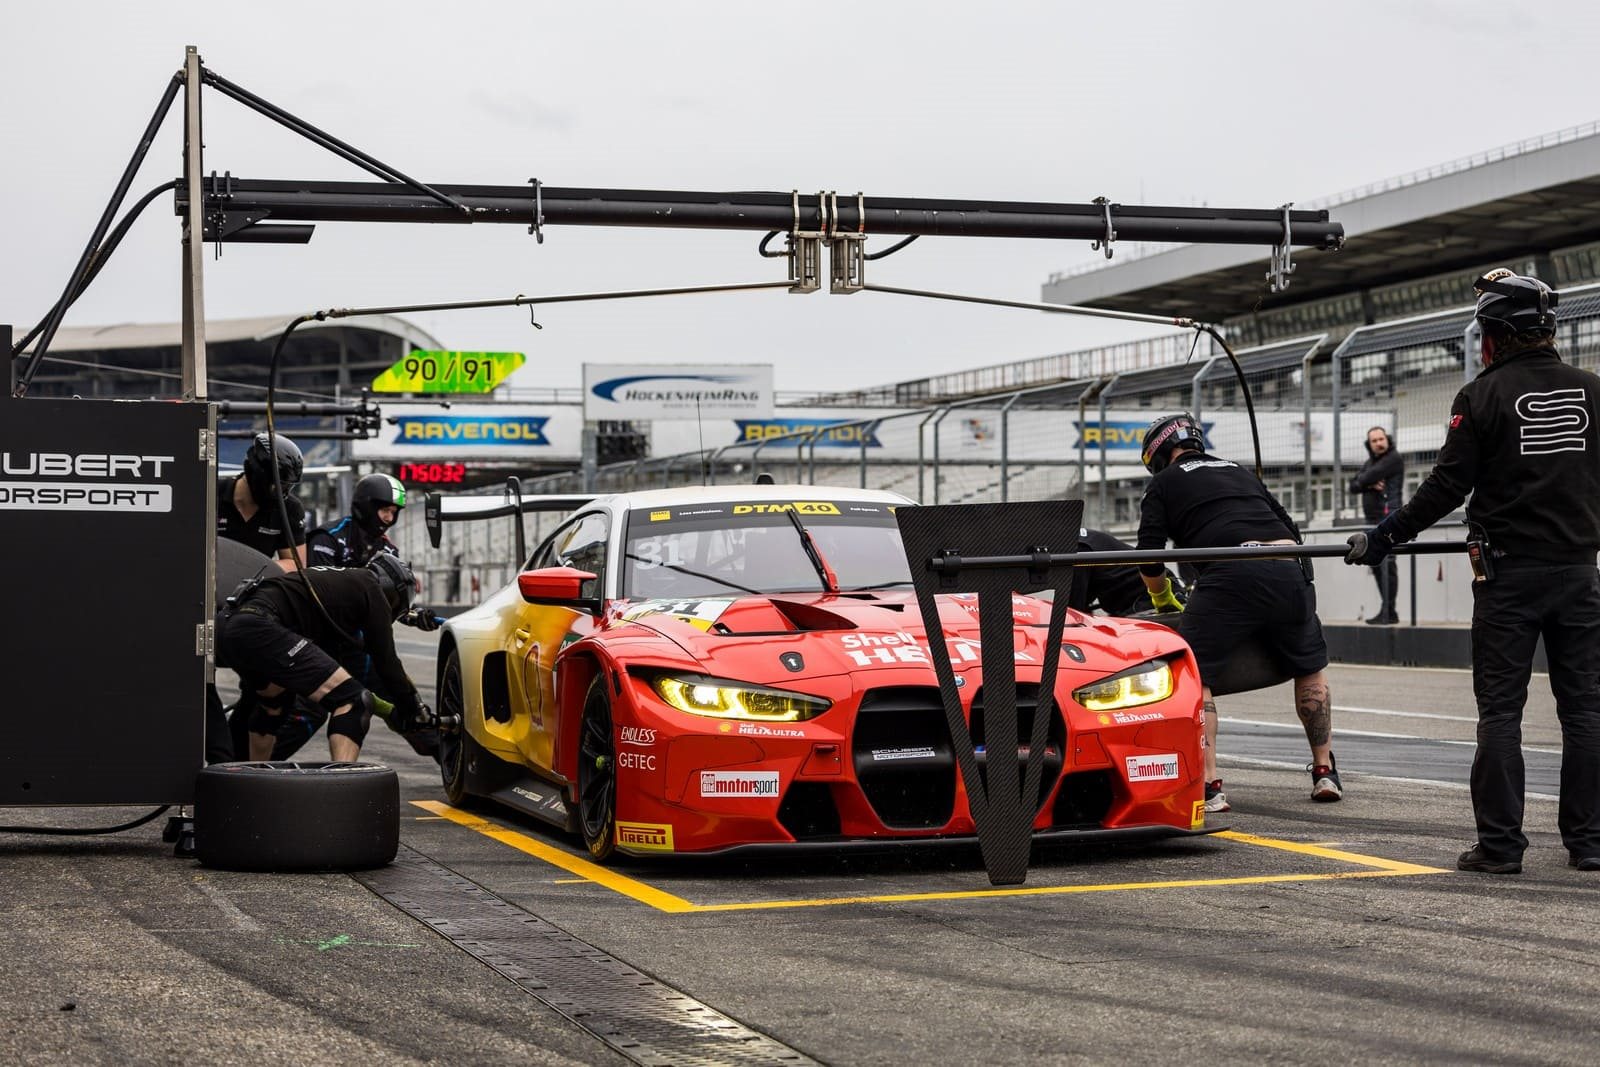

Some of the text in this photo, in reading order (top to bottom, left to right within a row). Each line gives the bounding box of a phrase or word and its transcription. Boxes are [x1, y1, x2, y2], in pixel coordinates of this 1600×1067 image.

[405, 359, 436, 381] 90
[464, 359, 492, 381] 91
[404, 422, 539, 440] RAVENOL
[1083, 428, 1146, 444] RAVE
[733, 503, 795, 514] DTM
[636, 540, 685, 570] 31
[840, 631, 918, 649] Shell
[621, 726, 657, 743] ENDLESS
[738, 726, 805, 737] HELIX ULTRA
[619, 752, 656, 771] GETEC
[715, 778, 778, 795] motorsport
[619, 826, 666, 845] PIRELLI
